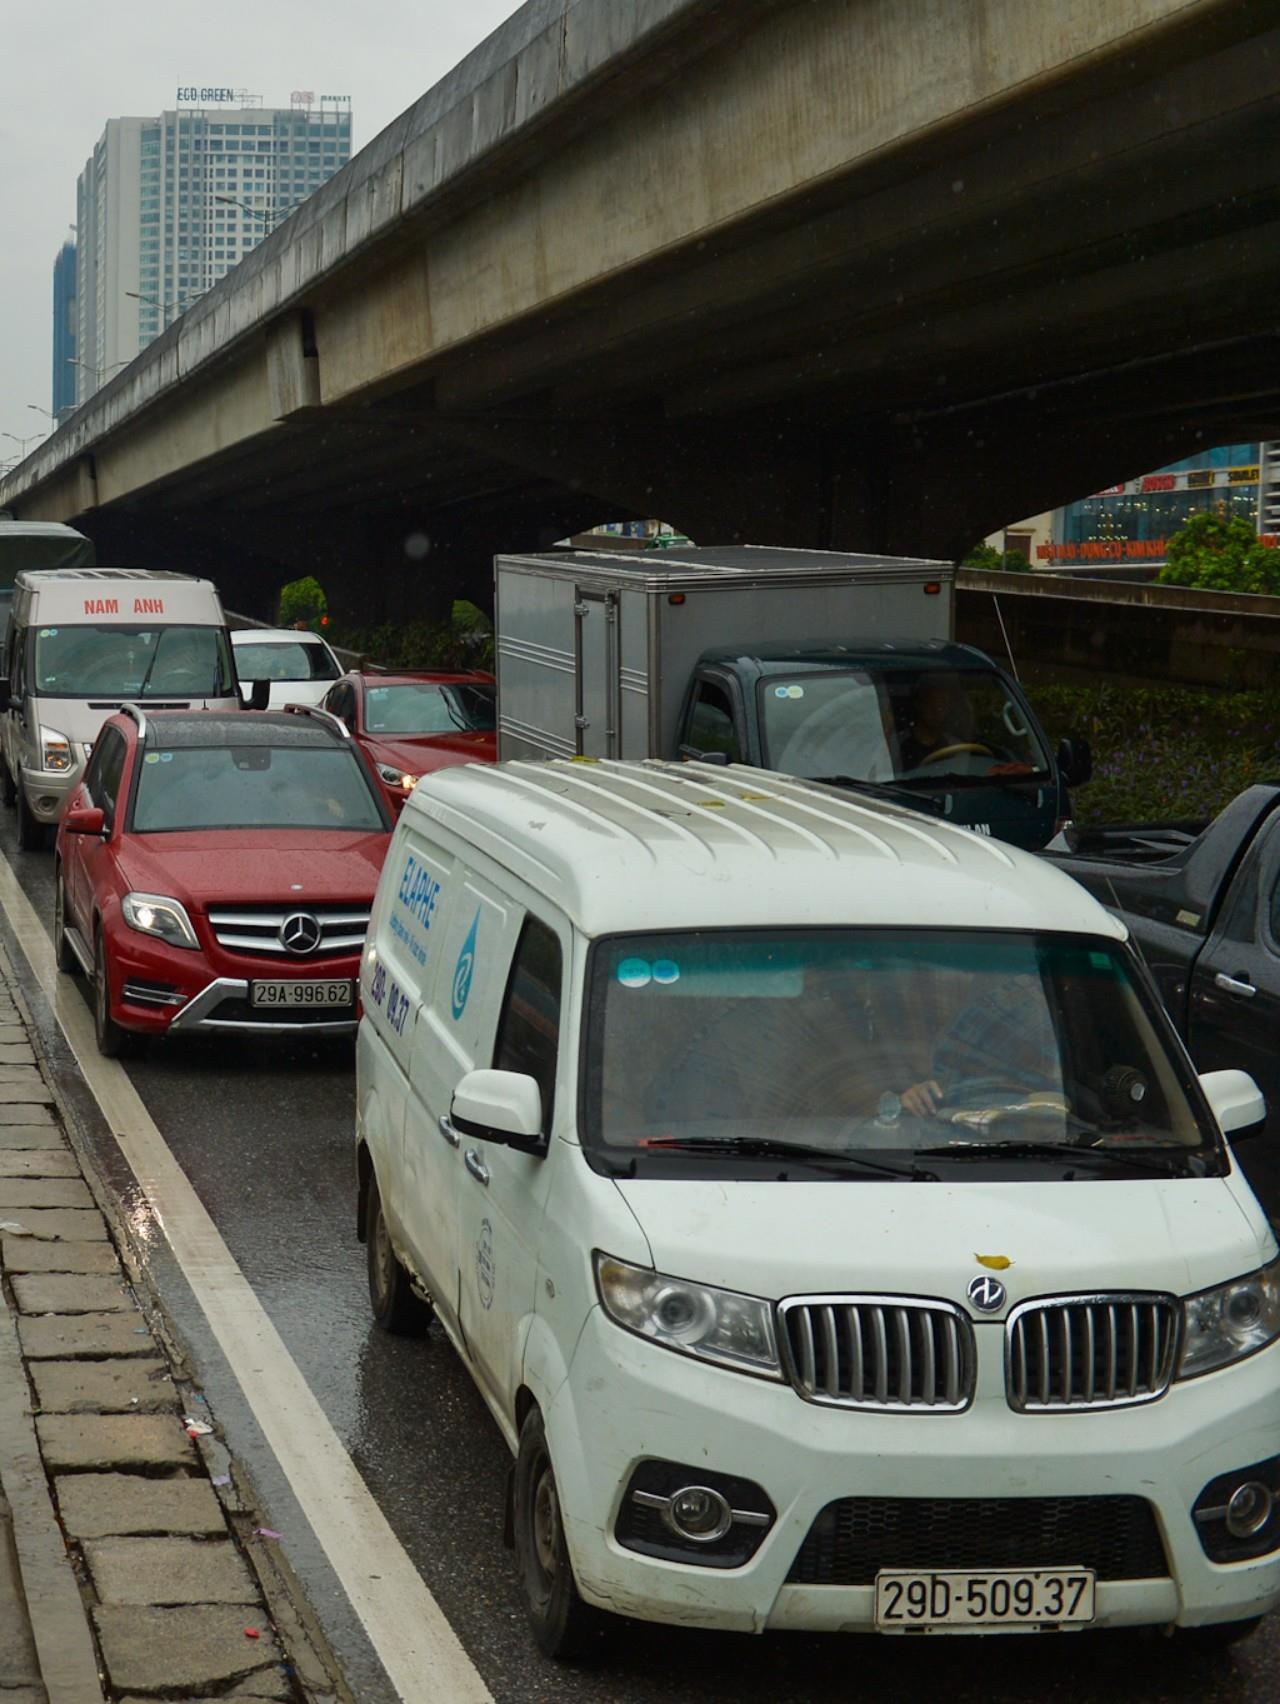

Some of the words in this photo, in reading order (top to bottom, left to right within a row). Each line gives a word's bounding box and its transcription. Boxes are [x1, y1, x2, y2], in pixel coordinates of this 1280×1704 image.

[177, 87, 197, 101] ECO
[201, 88, 234, 102] GREEN
[84, 599, 119, 614] NAM
[134, 599, 164, 614] ANH
[256, 984, 349, 1003] 29A-996.62
[882, 1576, 1088, 1620] 29D-509.37
